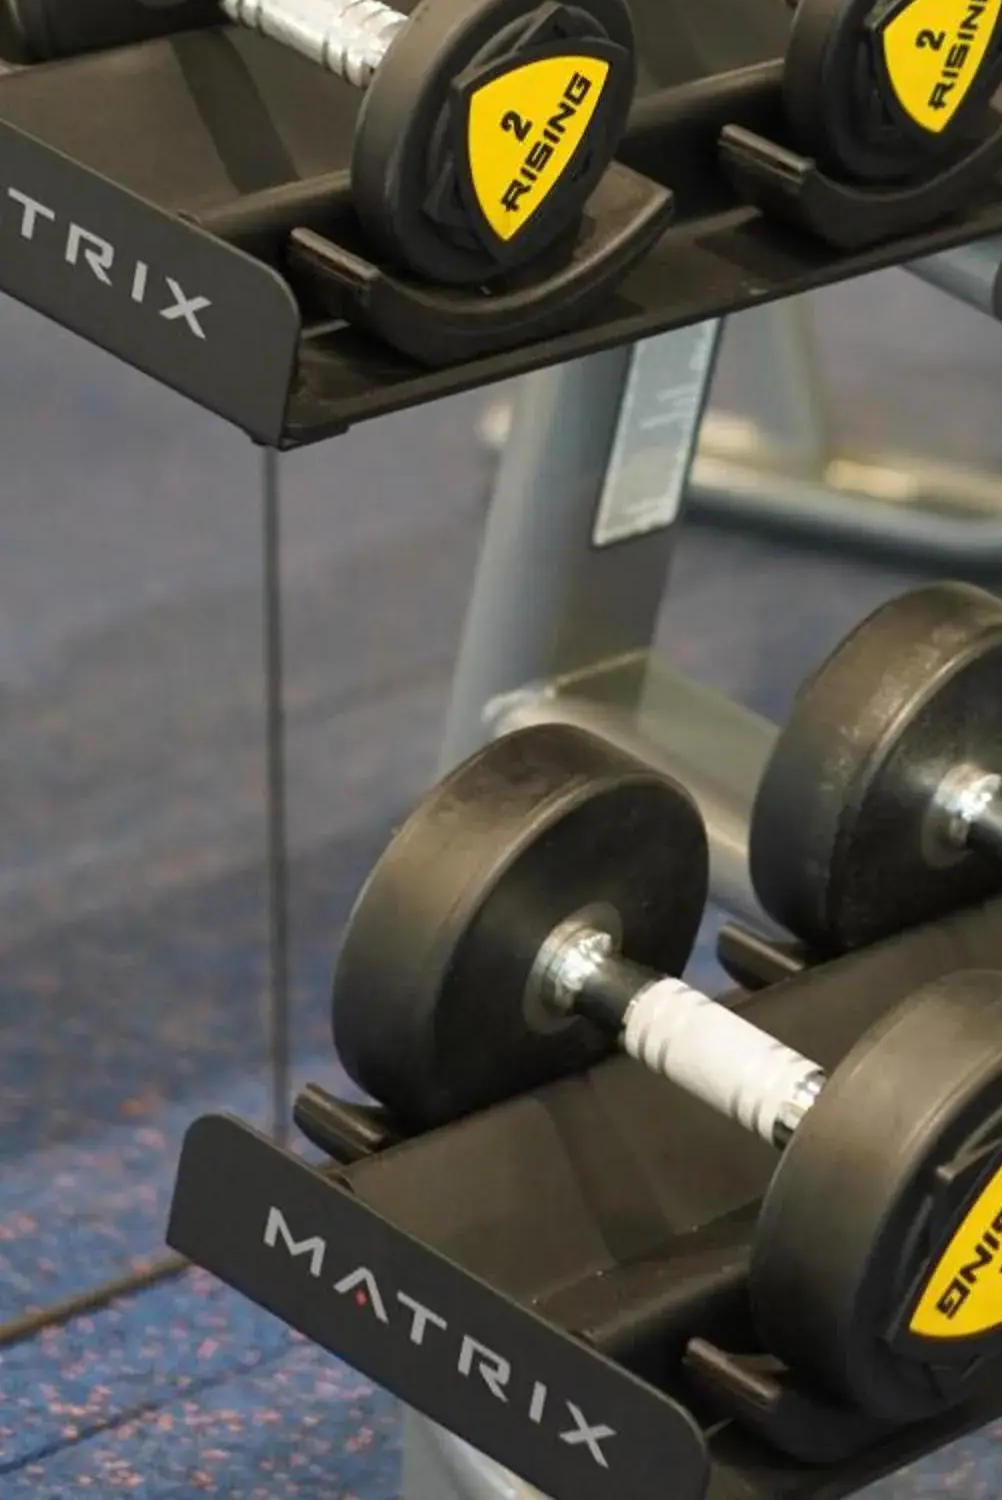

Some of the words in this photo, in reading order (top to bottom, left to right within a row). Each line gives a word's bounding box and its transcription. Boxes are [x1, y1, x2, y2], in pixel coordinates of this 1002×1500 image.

[914, 28, 946, 52] 2
[500, 109, 533, 143] 2
[501, 71, 592, 213] RISING
[7, 186, 213, 341] TRIX
[264, 1205, 617, 1469] MATRIX
